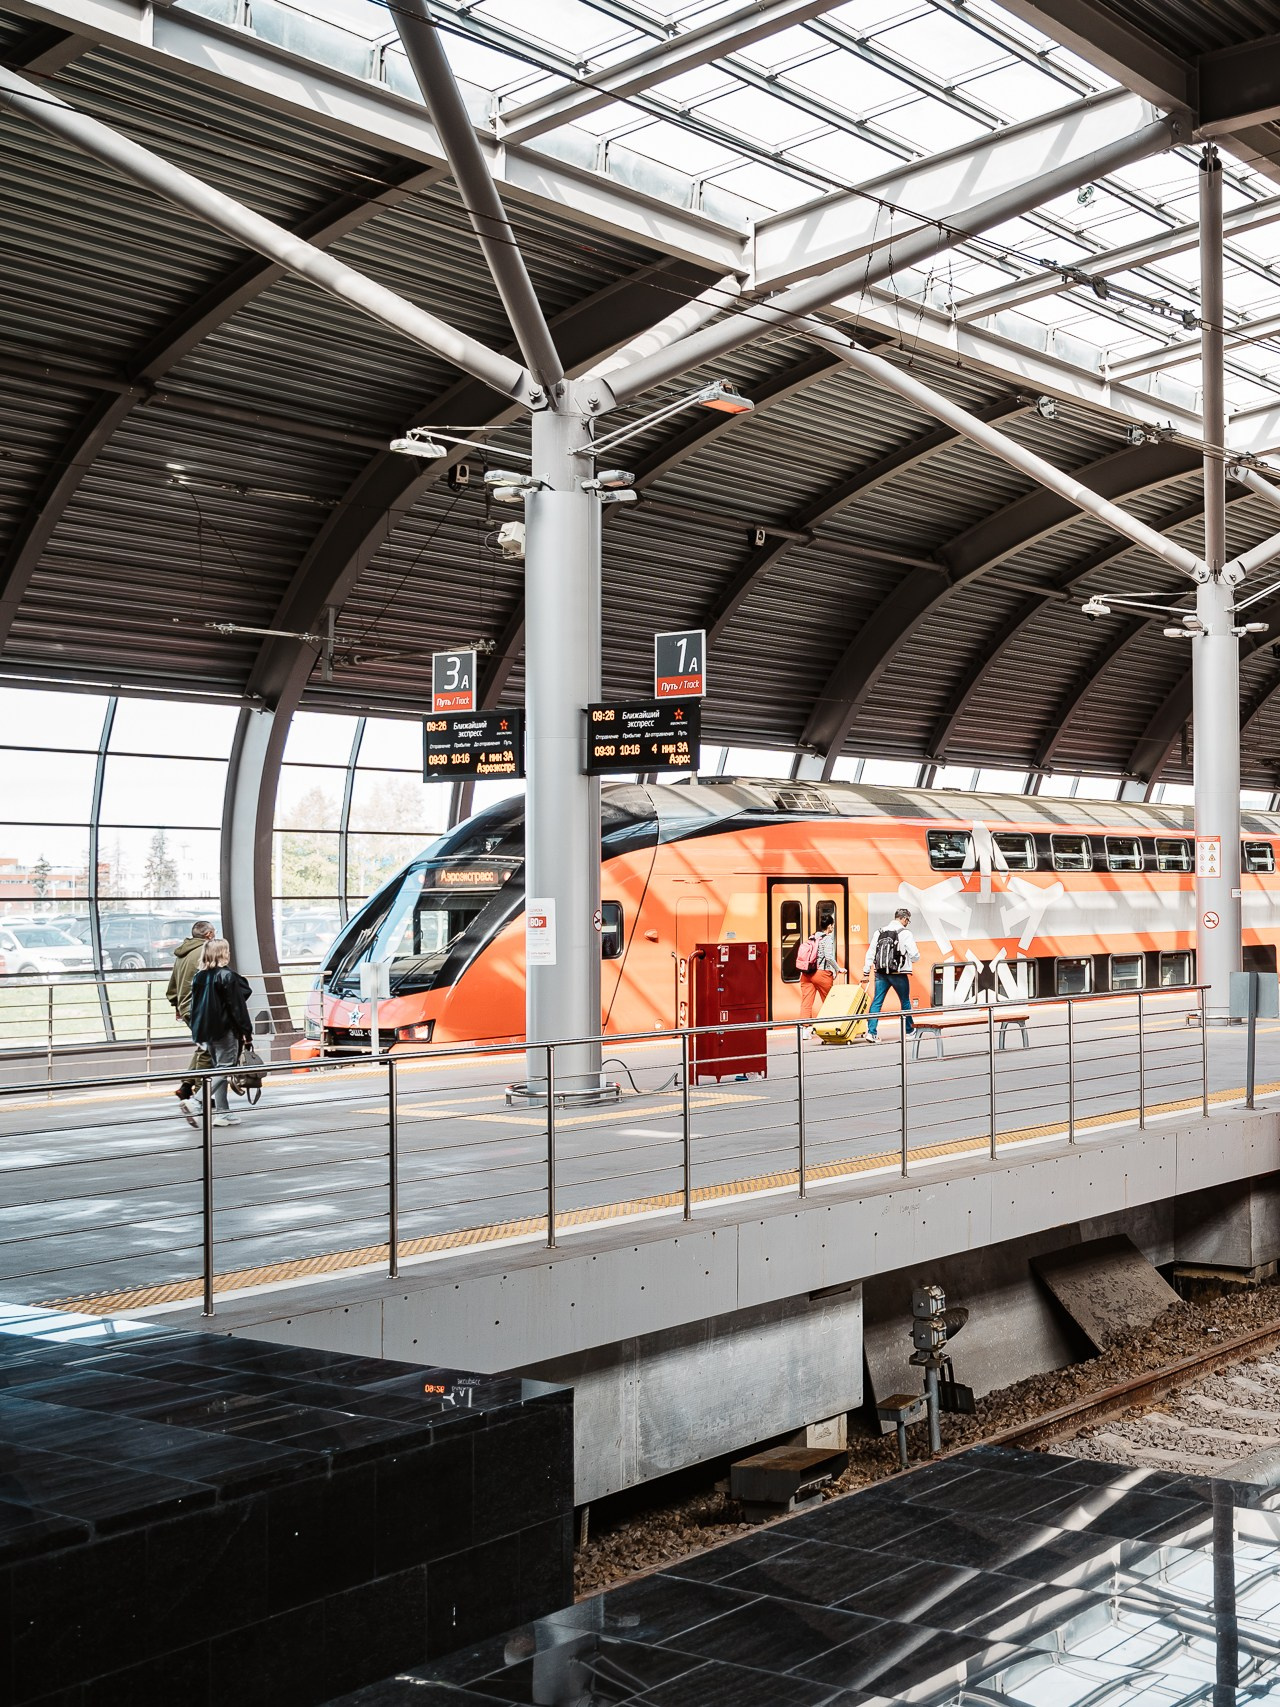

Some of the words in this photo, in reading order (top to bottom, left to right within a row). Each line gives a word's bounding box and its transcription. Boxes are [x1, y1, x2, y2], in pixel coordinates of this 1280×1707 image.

[661, 682, 678, 692] Путь
[684, 680, 700, 689] Track
[436, 698, 451, 707] Путь
[456, 696, 470, 705] Track
[592, 710, 615, 721] 09:26
[622, 710, 660, 720] Ближайший
[426, 721, 447, 732] 09:26
[453, 720, 487, 730] Ближайший
[627, 720, 654, 729] экспресс
[458, 730, 482, 739] экспресс
[594, 746, 615, 757] 09:30
[620, 744, 640, 756] 10:16
[651, 744, 657, 754] 4
[428, 754, 447, 765] 09:30
[451, 753, 470, 764] 10:16
[480, 752, 485, 762] 4
